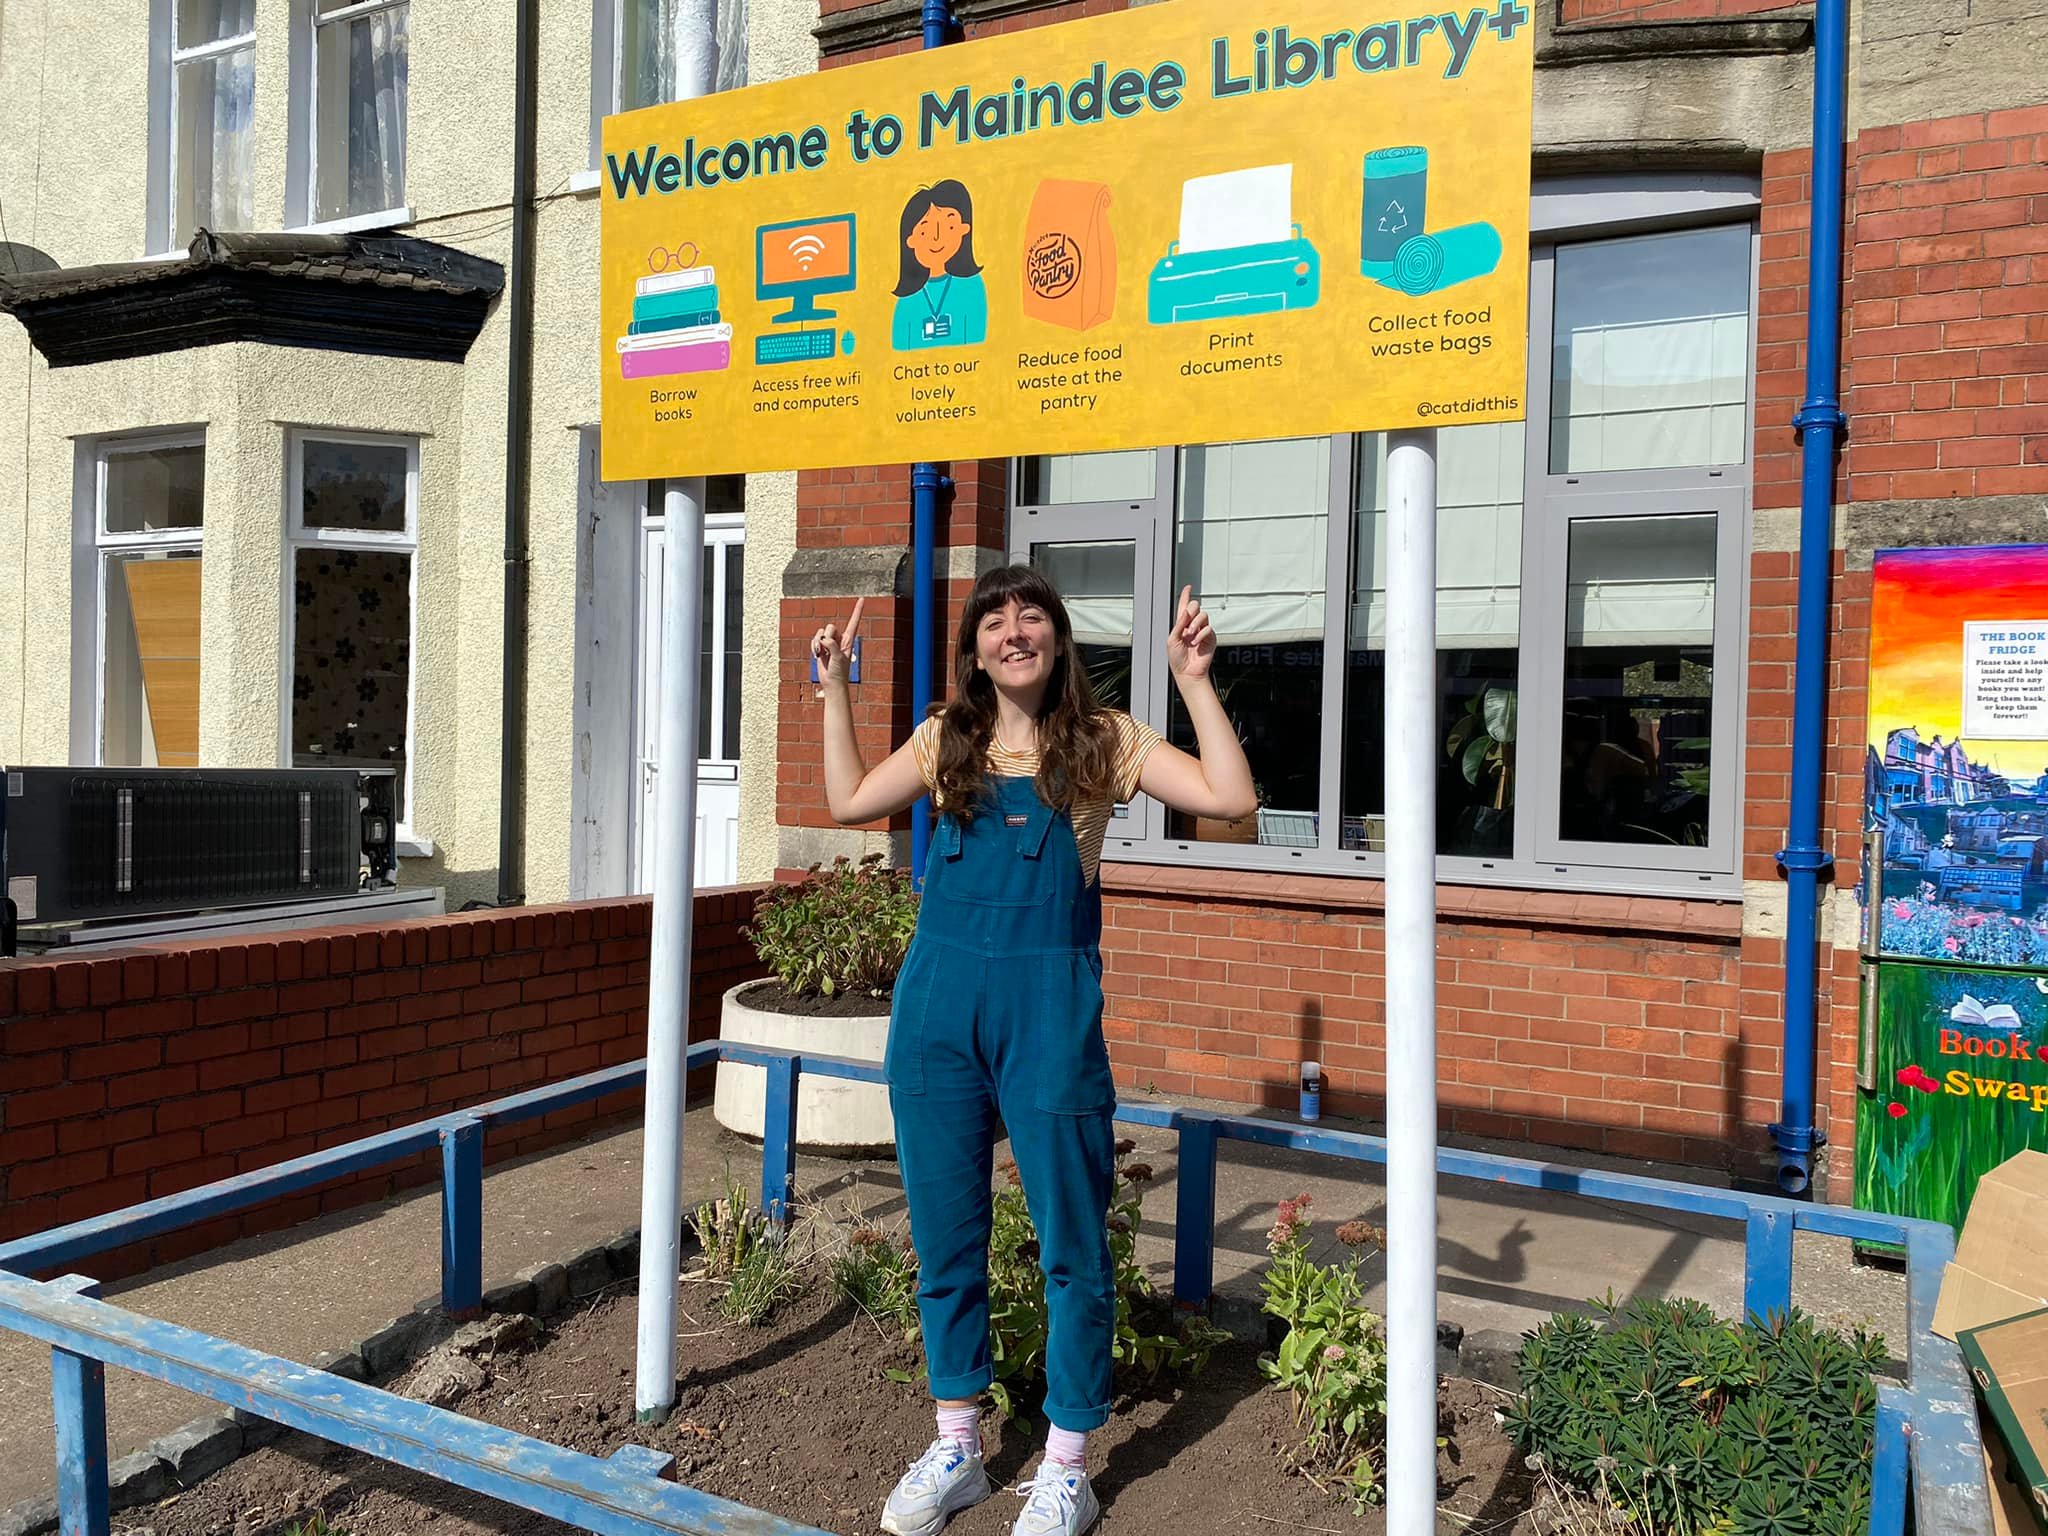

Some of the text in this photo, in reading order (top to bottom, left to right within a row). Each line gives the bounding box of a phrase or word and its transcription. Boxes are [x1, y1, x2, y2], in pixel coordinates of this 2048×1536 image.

[604, 0, 1529, 199] Welcome to Maindee Library+
[1030, 258, 1075, 294] Pantry
[1369, 307, 1490, 332] Collect food
[1210, 333, 1253, 349] Print
[1372, 336, 1491, 356] waste bags
[1019, 344, 1121, 368] Reduce food
[1181, 355, 1281, 375] documents
[894, 361, 979, 380] Chat to our
[1018, 369, 1121, 389] waste at the
[753, 372, 860, 392] Access free wifi
[651, 391, 697, 402] Borrow
[754, 395, 859, 412] and computers
[912, 386, 954, 401] lovely
[1042, 394, 1096, 413] pantry
[656, 408, 691, 421] books
[896, 404, 976, 423] volunteers
[1418, 396, 1517, 416] @catdidthis
[1980, 632, 2045, 641] THE BOOK
[1989, 646, 2036, 654] FRIDGE
[1939, 1029, 2032, 1060] Book
[1944, 1070, 2048, 1112] Swap
